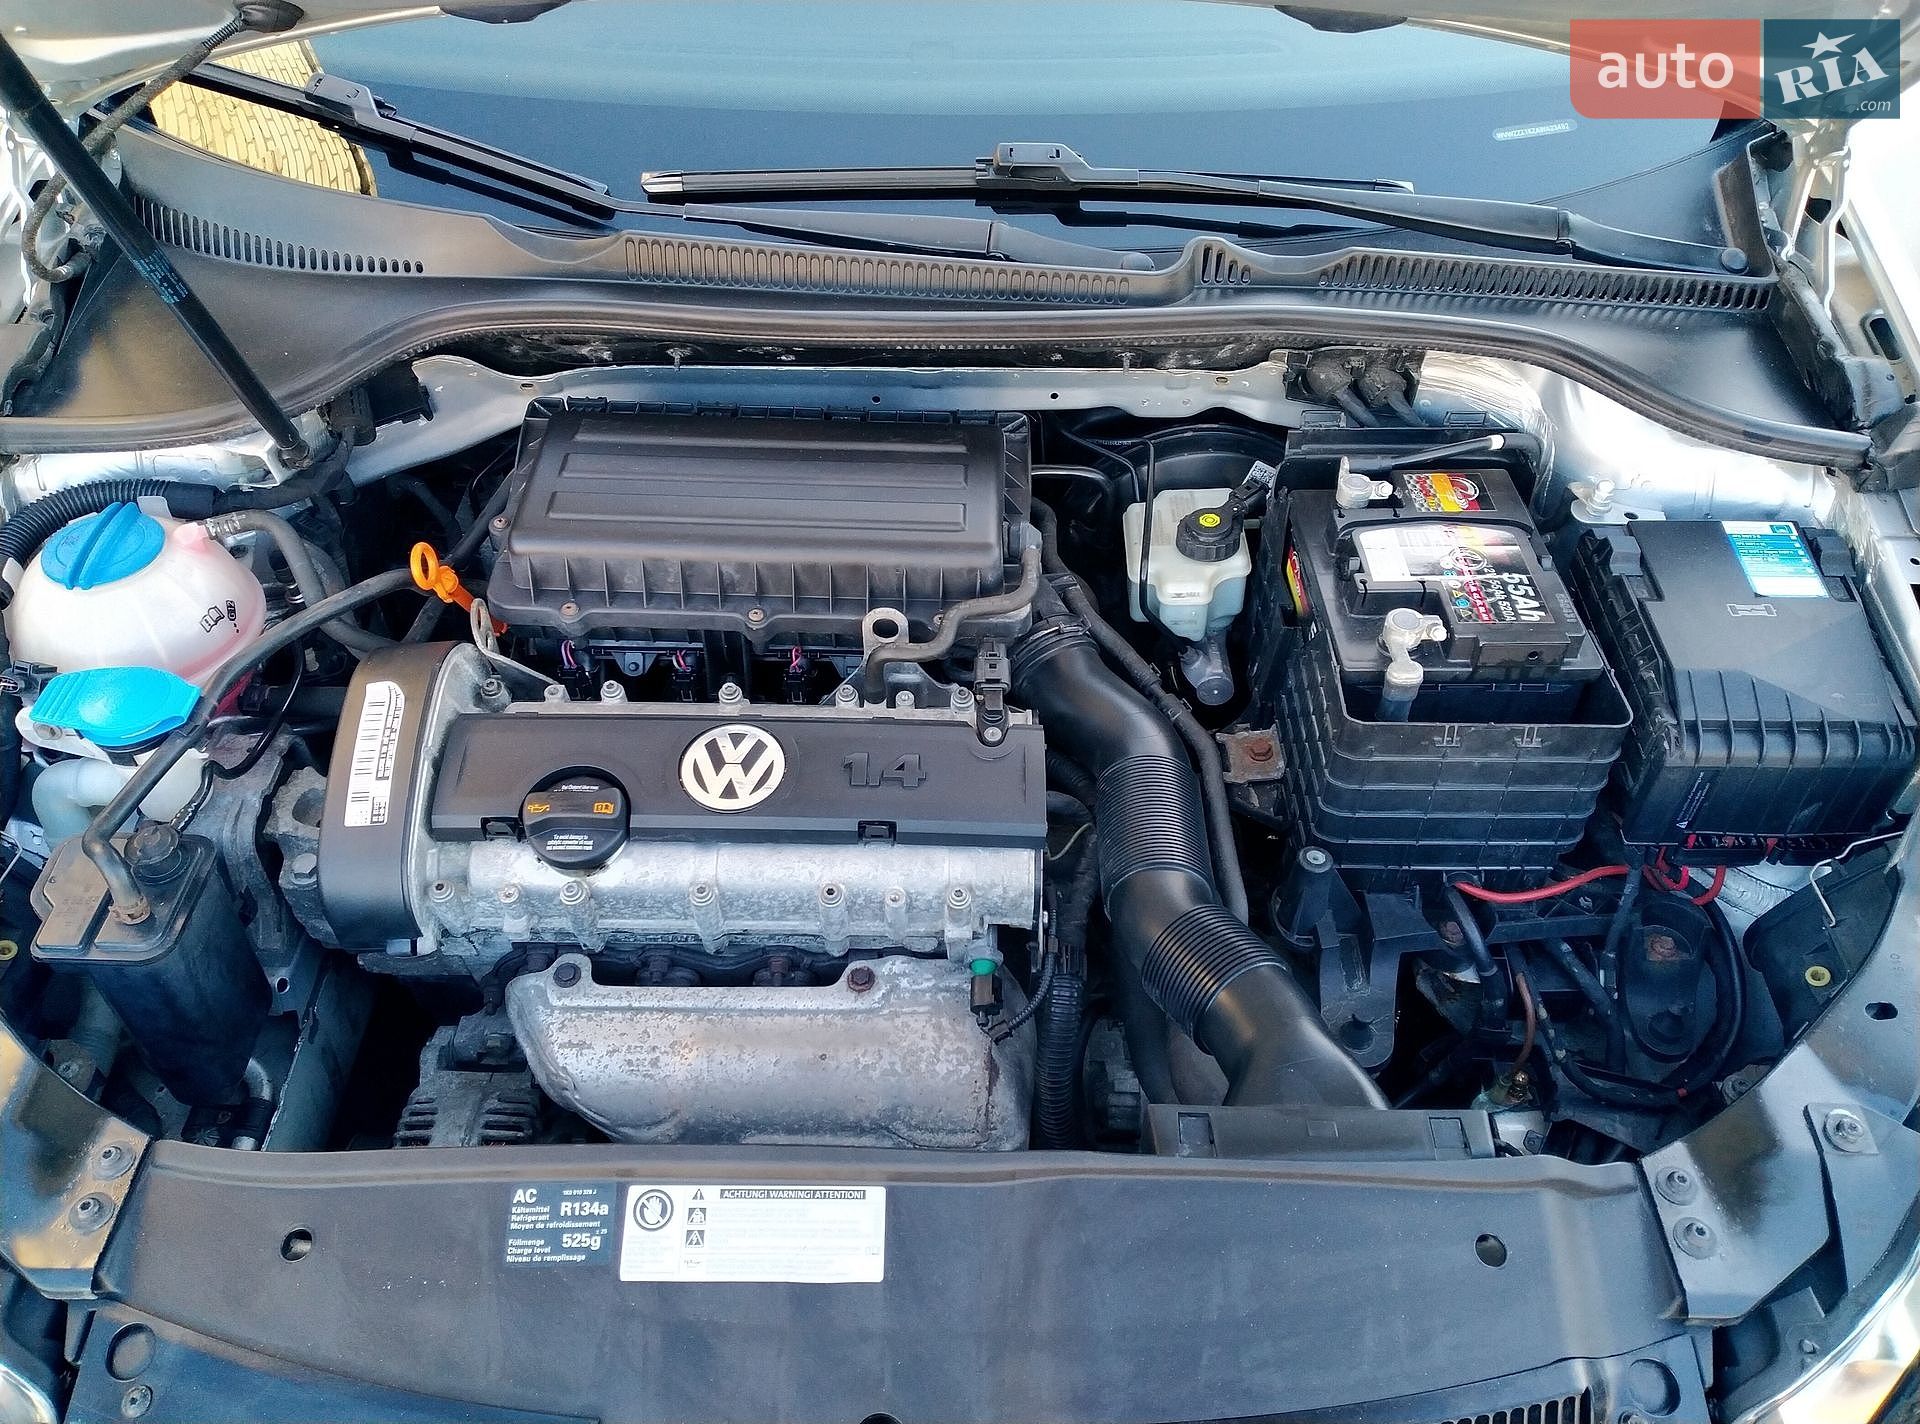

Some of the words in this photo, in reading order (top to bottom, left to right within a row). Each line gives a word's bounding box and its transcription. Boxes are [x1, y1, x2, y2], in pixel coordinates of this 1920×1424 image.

[1502, 572, 1547, 622] 55Ah
[226, 600, 236, 621] G12
[842, 752, 927, 788] 1.4
[512, 1188, 538, 1204] AC
[722, 1189, 768, 1199] ACHTUNG!
[769, 1189, 814, 1199] WARNING!
[815, 1190, 864, 1200] ATTENTION!
[511, 1206, 550, 1214] Kältemittel
[560, 1201, 609, 1217] R134a
[511, 1214, 550, 1222] Refrigerant
[546, 1220, 601, 1229] refroidissement
[508, 1239, 545, 1247] Füllmenge
[561, 1232, 602, 1251] 525g
[507, 1247, 533, 1255] Charge
[506, 1255, 531, 1263] Niveau
[532, 1254, 542, 1262] de
[543, 1253, 586, 1263] remplissage
